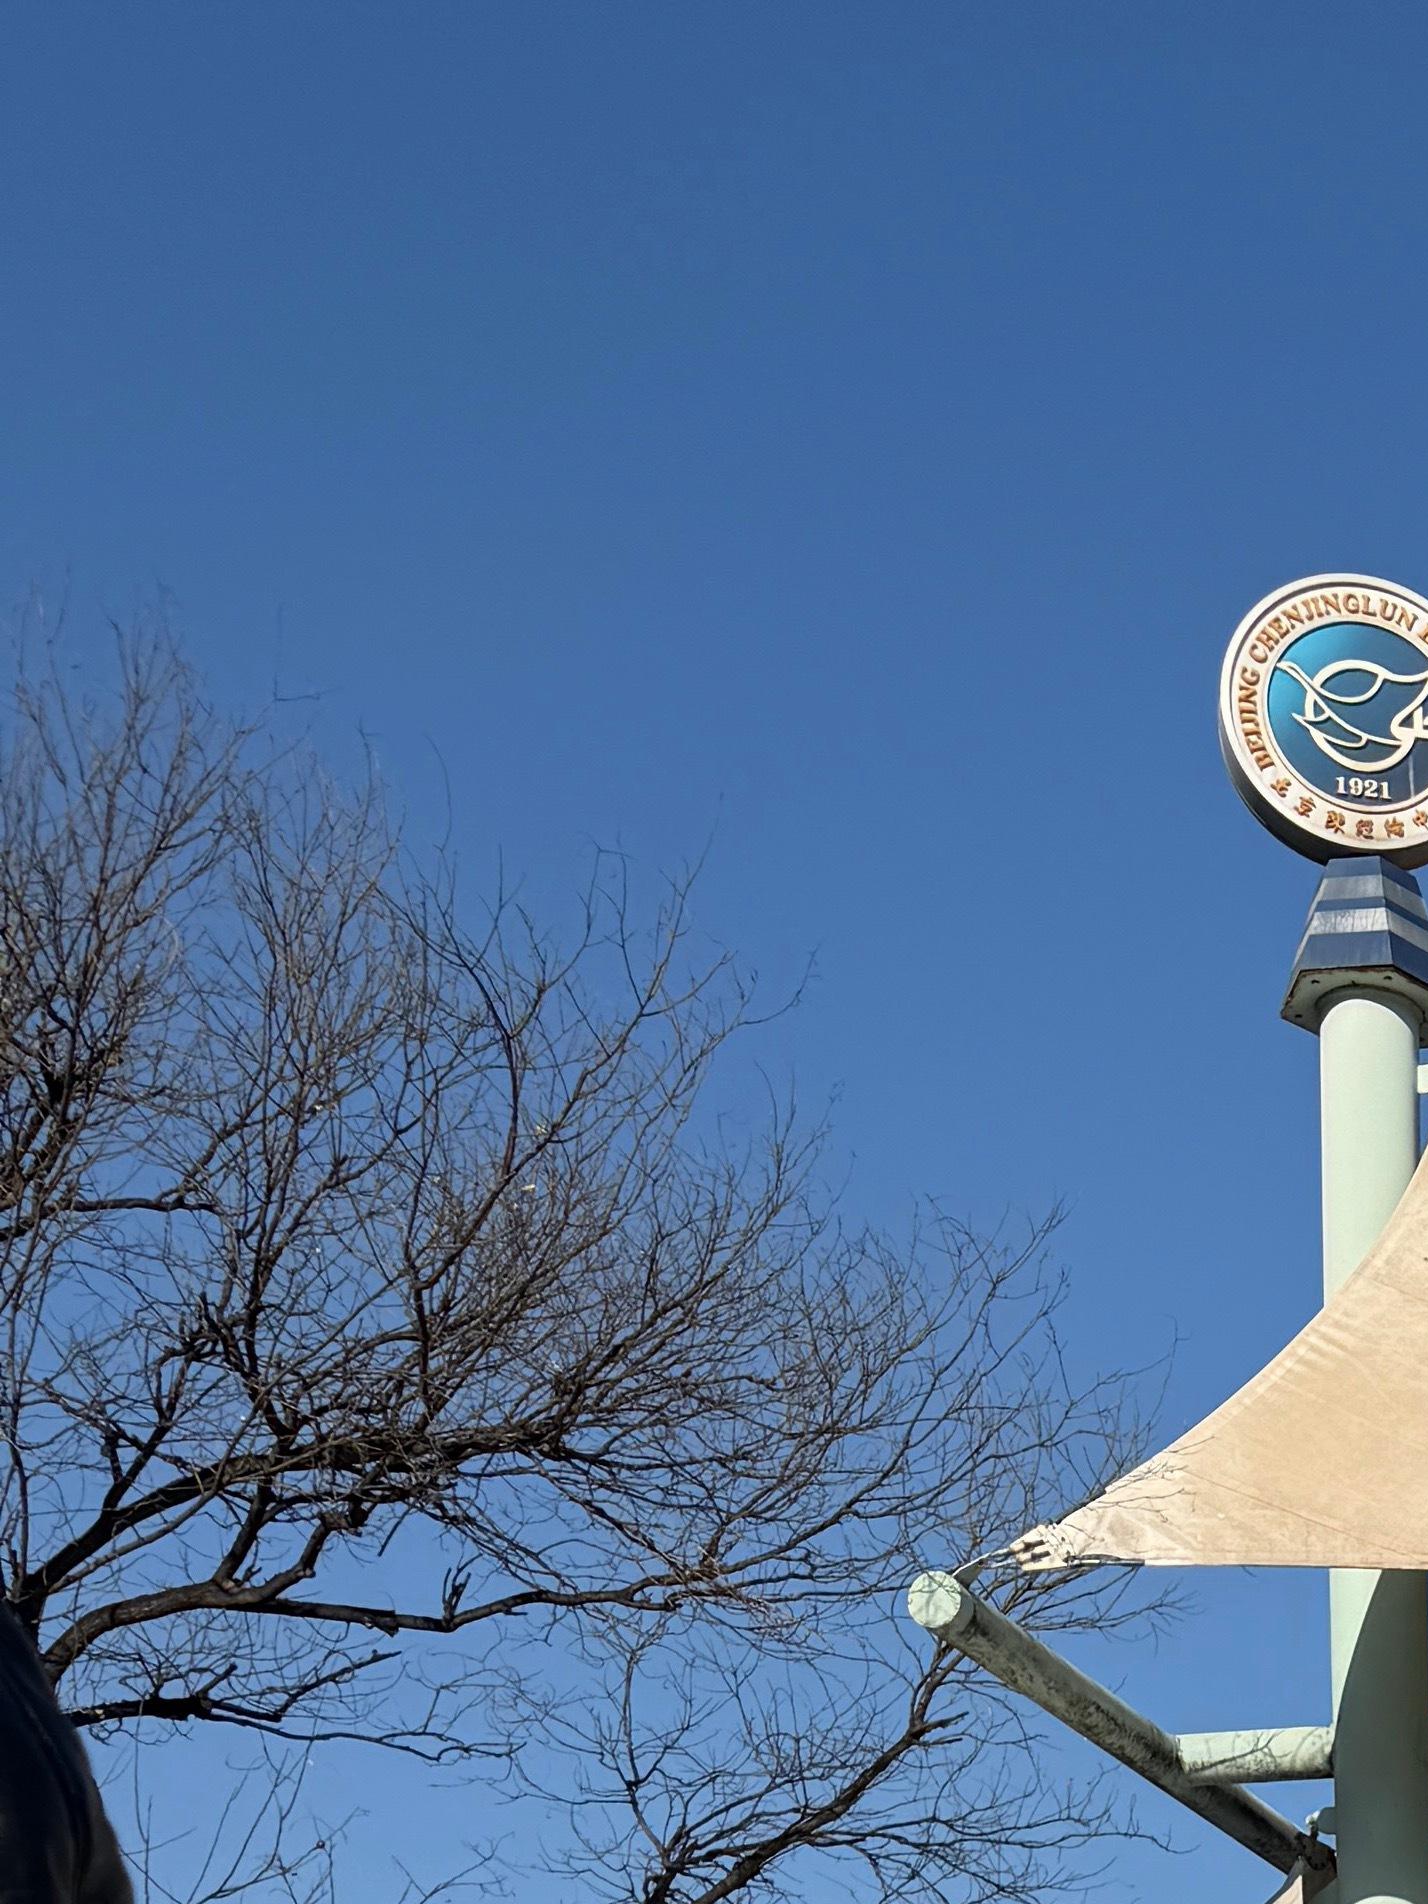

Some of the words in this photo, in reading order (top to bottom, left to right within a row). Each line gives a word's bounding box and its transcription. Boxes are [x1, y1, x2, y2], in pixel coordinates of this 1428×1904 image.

[1249, 593, 1419, 664] CHENJINGLUN
[1238, 666, 1276, 771] BEIJING
[1336, 775, 1392, 800] 1921
